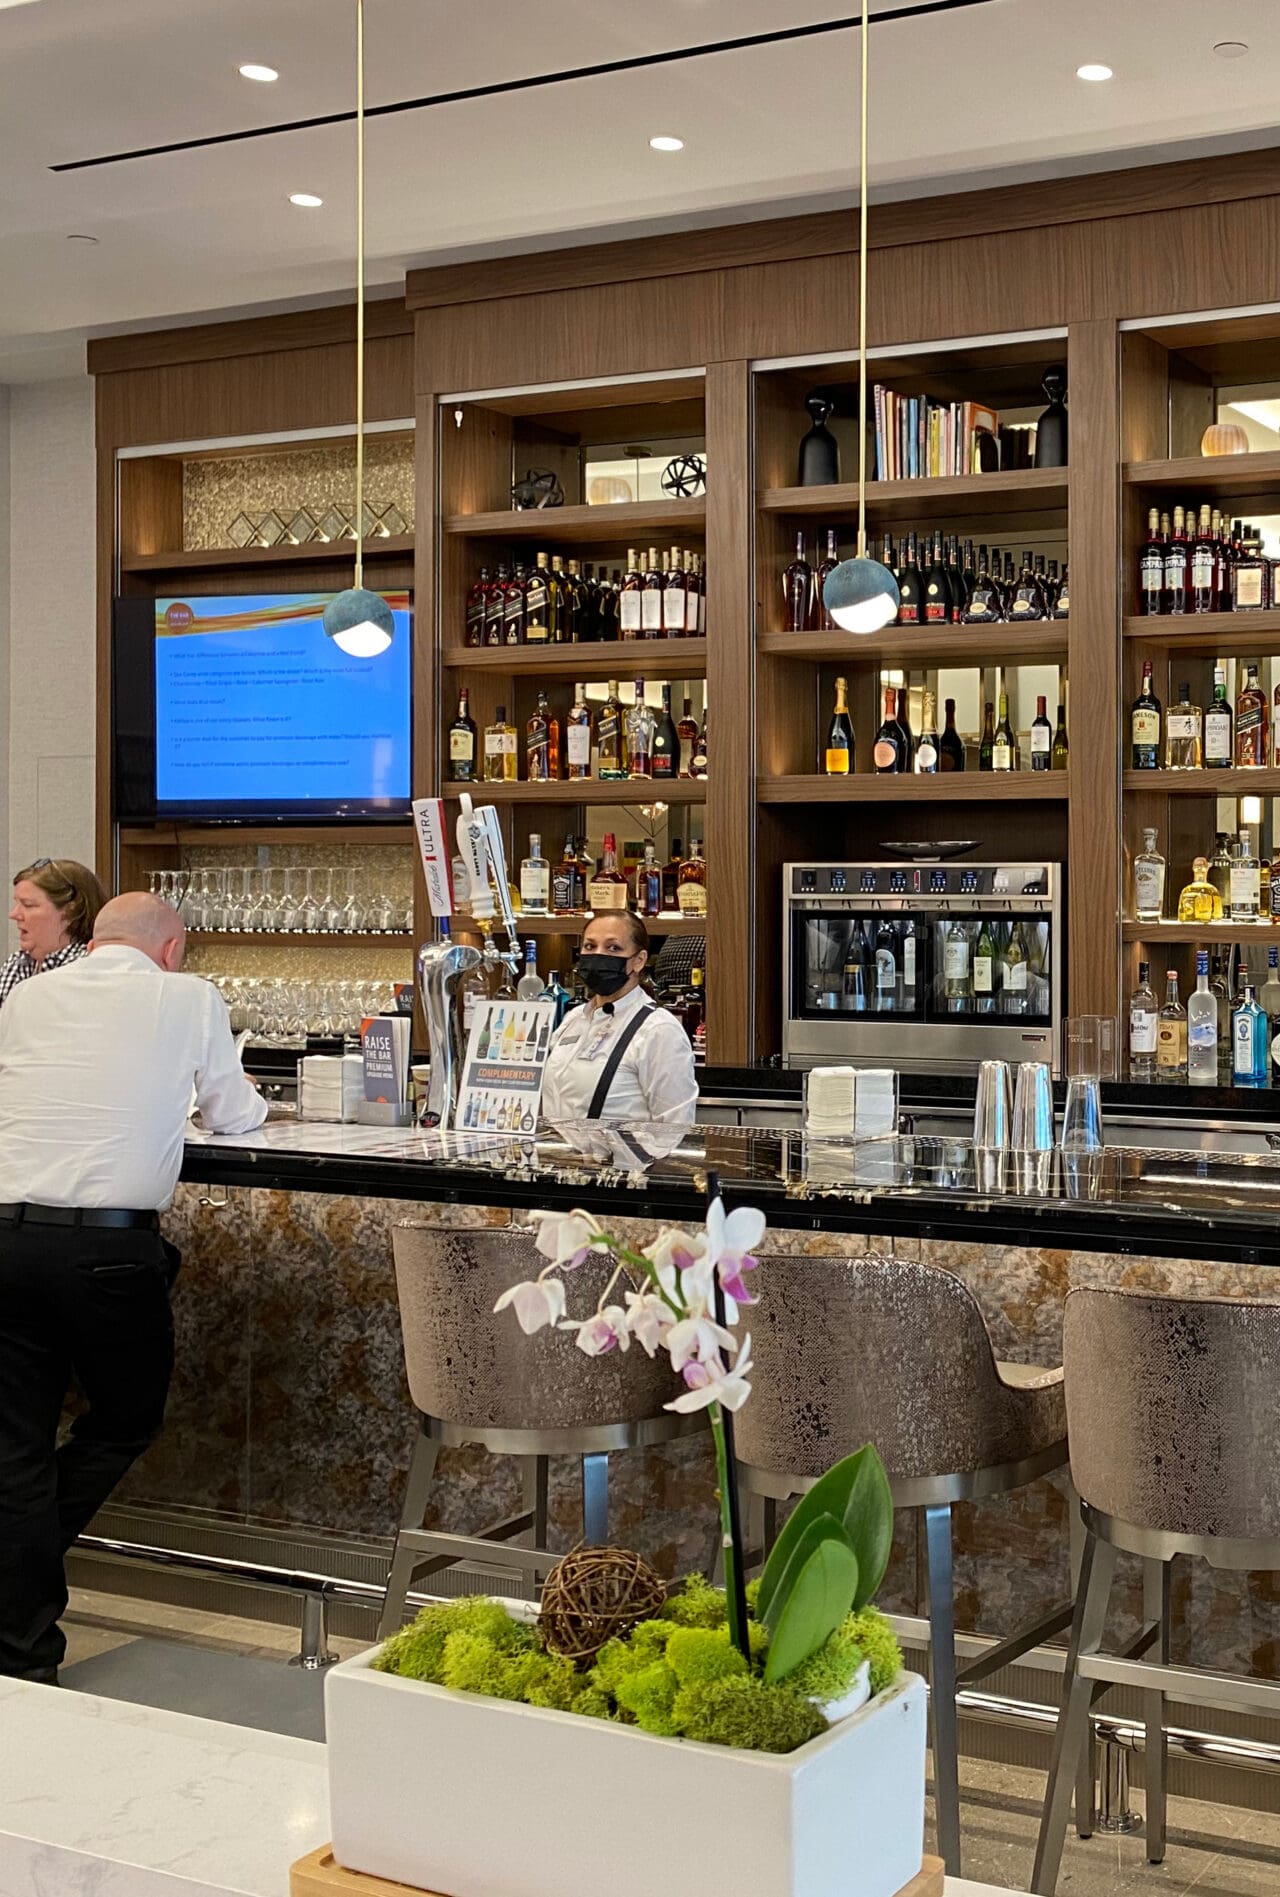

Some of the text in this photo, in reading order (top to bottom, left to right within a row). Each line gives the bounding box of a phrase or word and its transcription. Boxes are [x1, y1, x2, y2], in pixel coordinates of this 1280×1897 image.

[419, 808, 435, 853] ULTRA
[364, 1035, 391, 1050] RAISE
[366, 1050, 392, 1061] THE BAR
[366, 1062, 393, 1072] PREMIUM
[477, 1068, 537, 1081] COMPLIMENTARY
